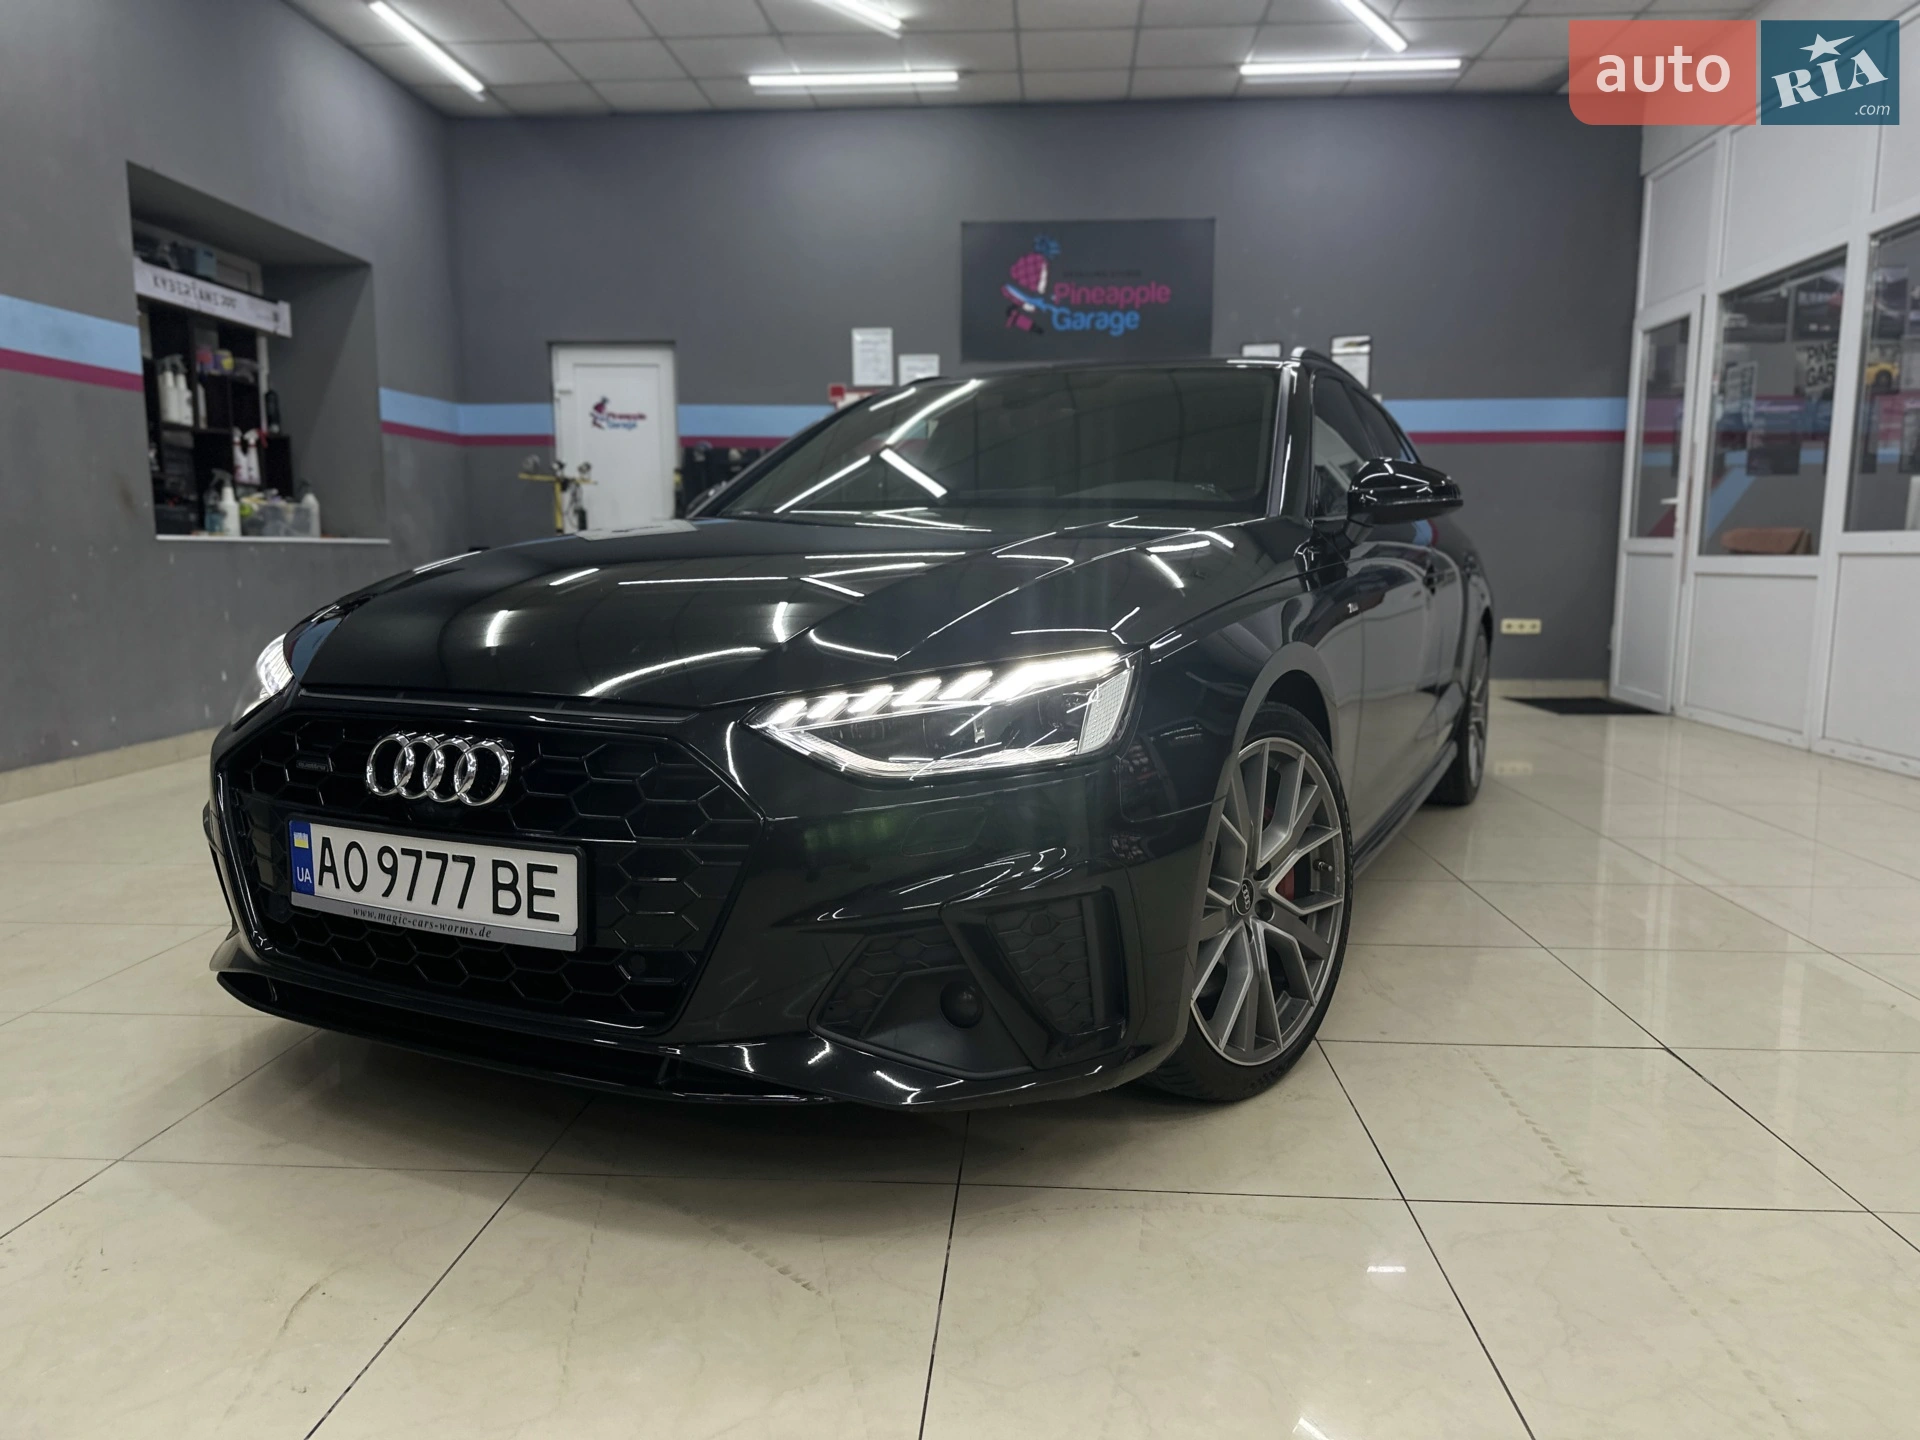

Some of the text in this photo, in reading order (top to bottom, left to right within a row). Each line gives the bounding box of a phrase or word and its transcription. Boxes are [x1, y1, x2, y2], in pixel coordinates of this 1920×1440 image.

[1054, 280, 1171, 309] Pineapple
[1052, 307, 1140, 336] Garage
[296, 866, 313, 884] UA
[318, 836, 560, 922] AO 9777 BE
[352, 907, 492, 939] www.magic-cars-worms.de
